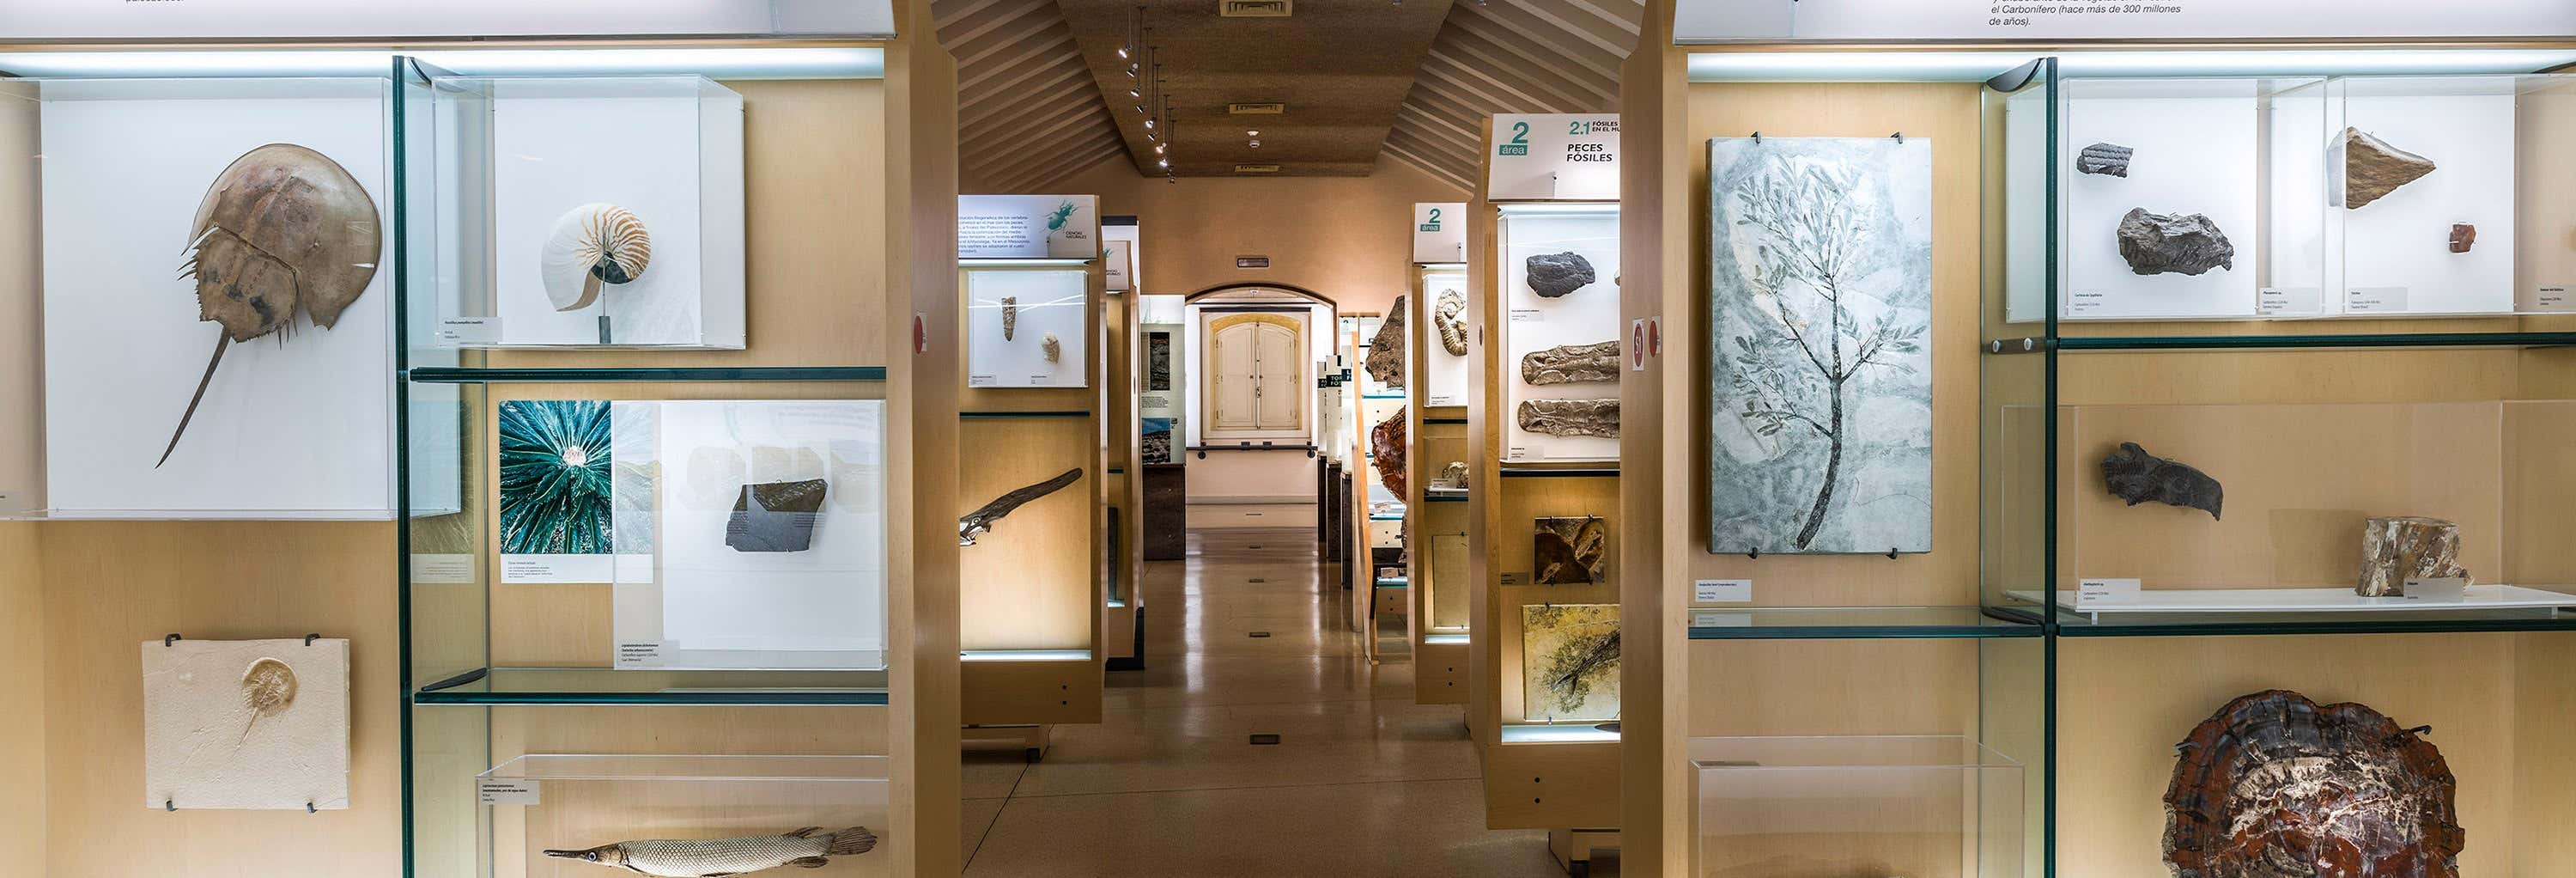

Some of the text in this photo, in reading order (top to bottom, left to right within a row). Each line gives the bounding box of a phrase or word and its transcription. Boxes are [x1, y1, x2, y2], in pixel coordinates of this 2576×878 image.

[1991, 4, 2182, 15] el Carbonífero (hace más de 300 millones
[1989, 17, 2031, 27] de años).
[1511, 121, 1529, 144] 2
[1569, 120, 1590, 135] 2.1
[1502, 145, 1526, 155] área
[1567, 143, 1603, 152] PECES
[1566, 152, 1613, 162] FÓSILES
[1429, 208, 1441, 223] 2
